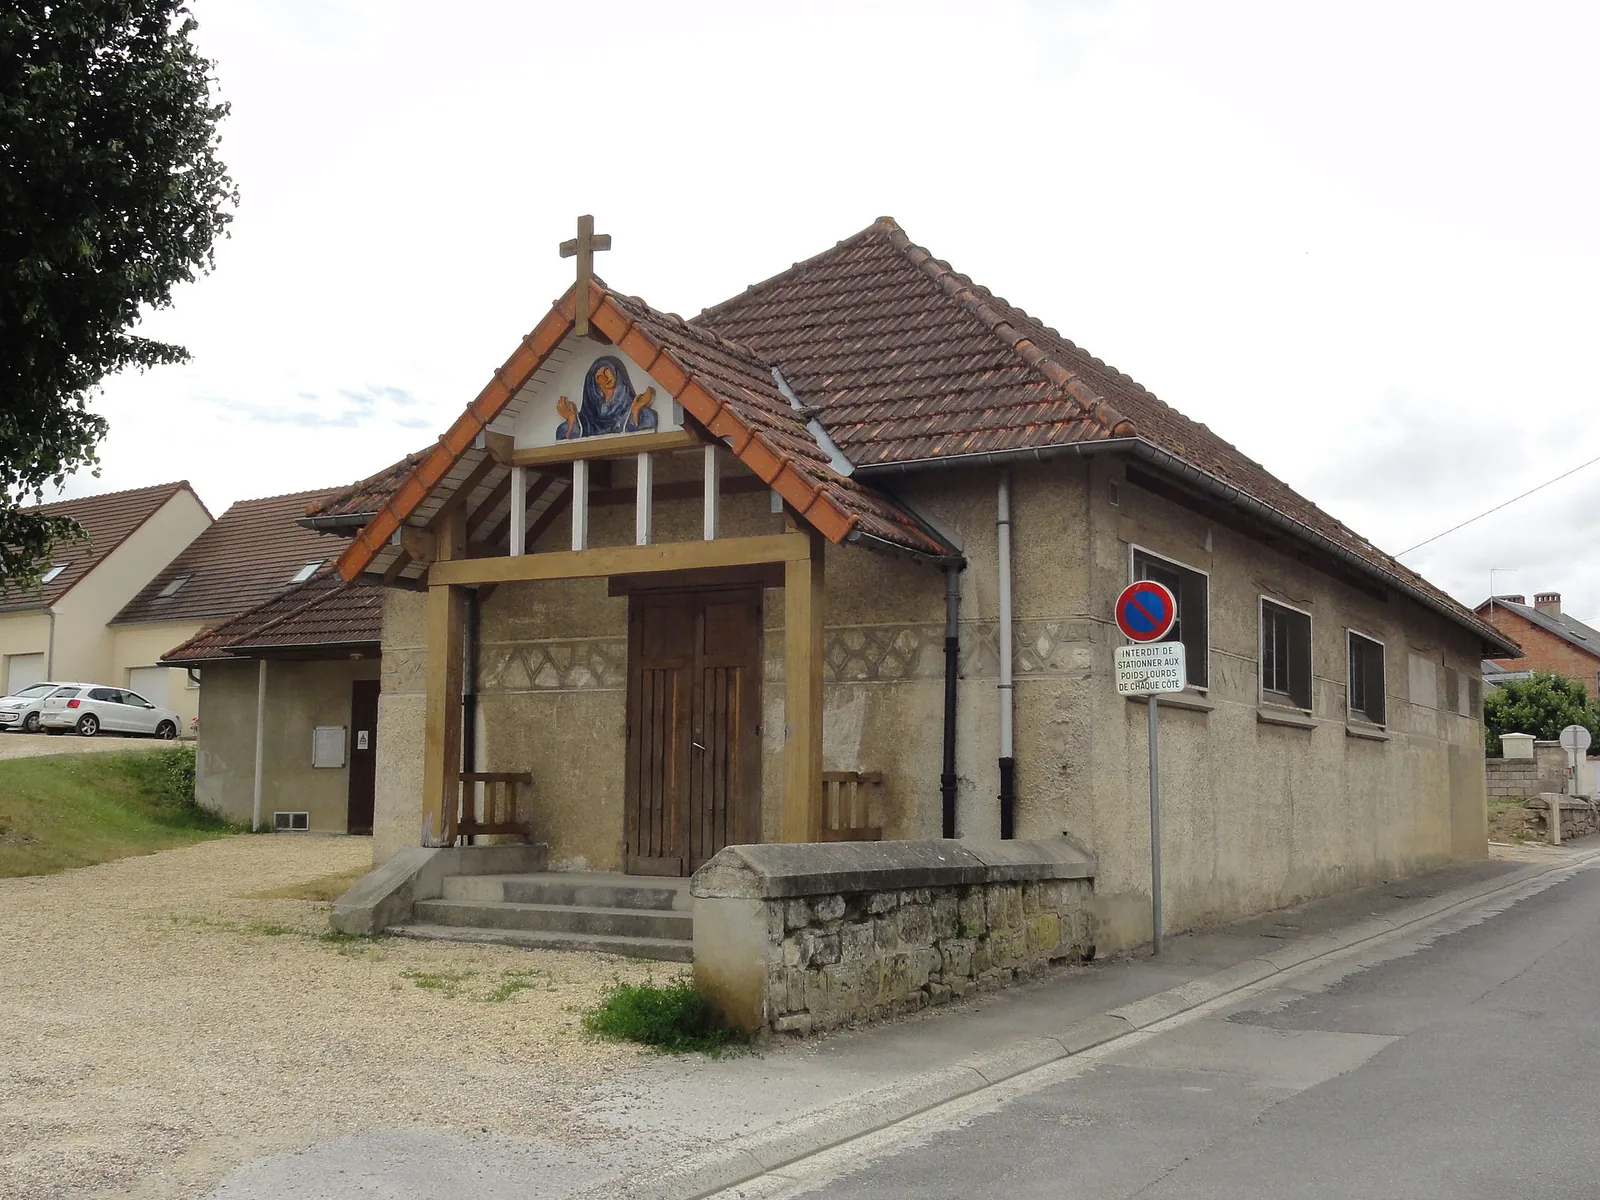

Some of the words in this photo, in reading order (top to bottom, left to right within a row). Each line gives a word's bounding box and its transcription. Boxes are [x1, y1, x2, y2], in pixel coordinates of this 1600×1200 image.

[1122, 647, 1159, 657] INTERDIT
[1163, 647, 1173, 655] DE
[1118, 659, 1162, 669] STATIONNER
[1164, 658, 1179, 666] AUX
[1121, 671, 1144, 679] POIDS
[1146, 669, 1176, 678] LOURDS
[1119, 683, 1128, 691] DE
[1130, 681, 1160, 690] CHAQUE
[1161, 680, 1179, 688] CÔTÉ
